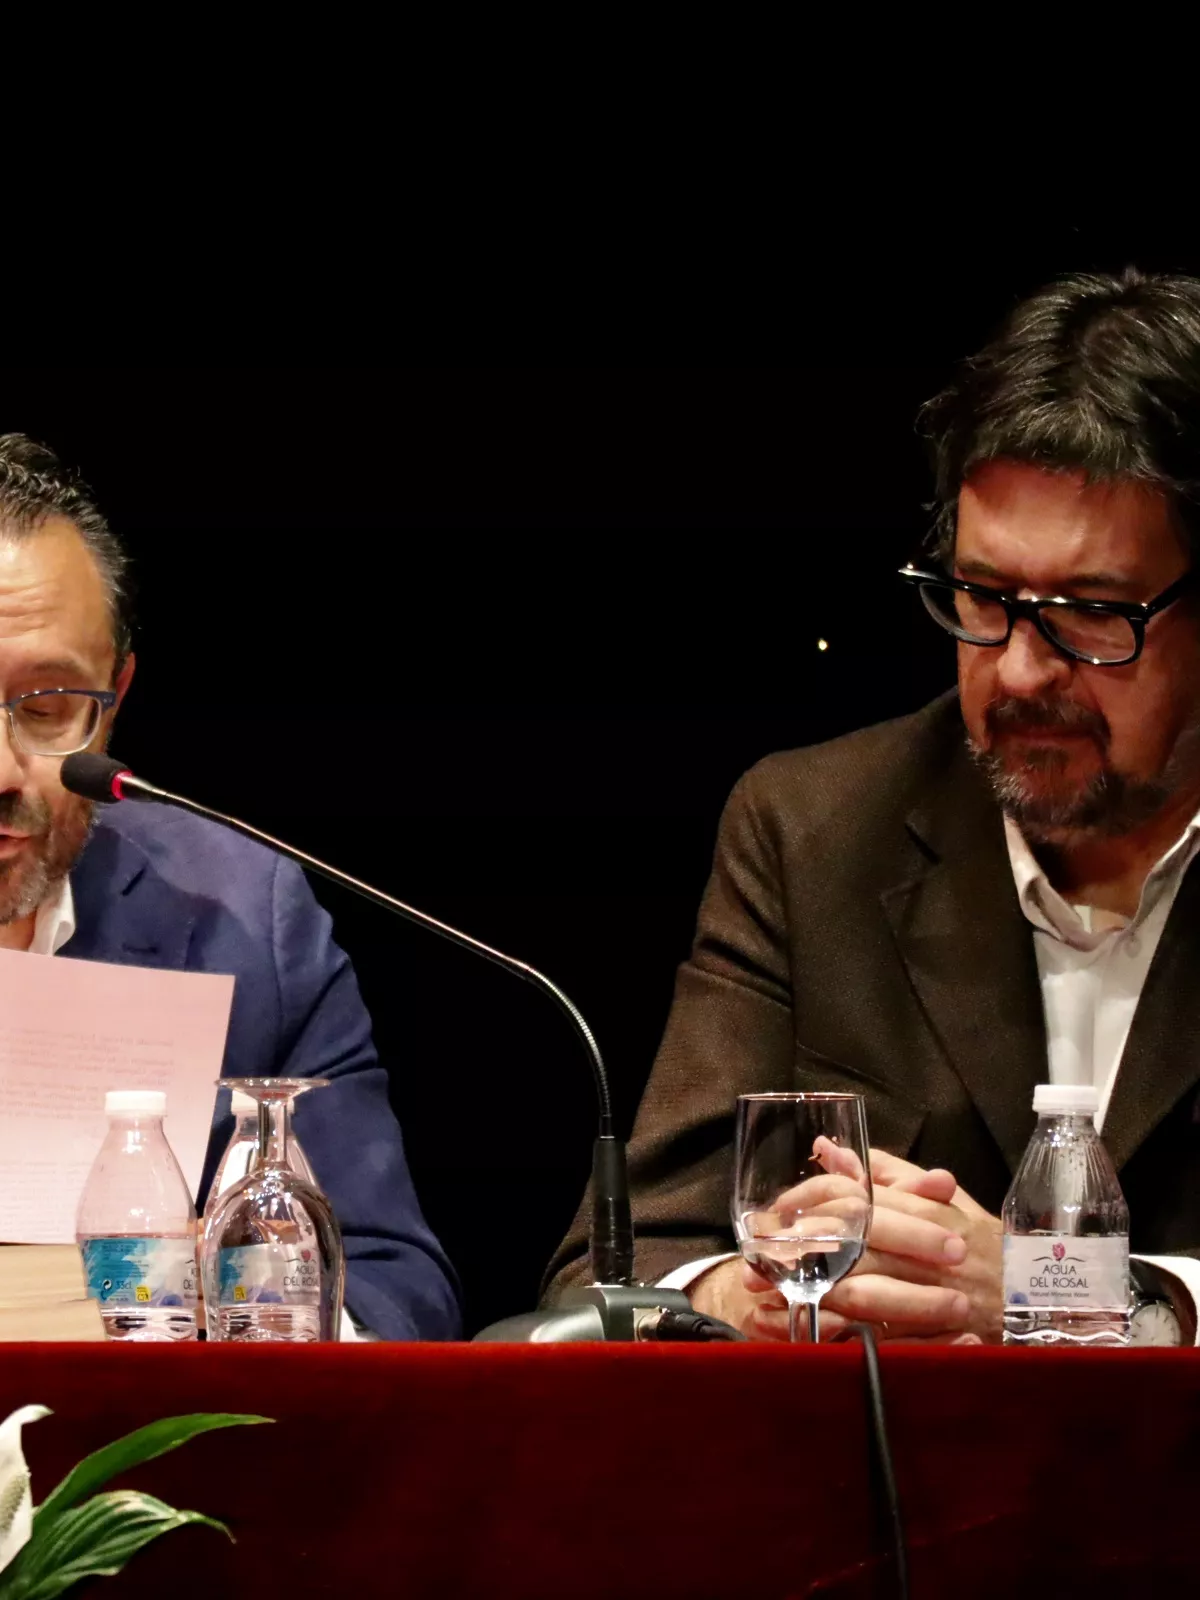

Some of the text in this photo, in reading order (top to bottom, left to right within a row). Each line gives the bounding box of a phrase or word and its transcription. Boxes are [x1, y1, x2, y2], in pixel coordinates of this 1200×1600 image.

[1042, 1264, 1077, 1275] AGUA
[1029, 1276, 1089, 1289] DEL ROSAL
